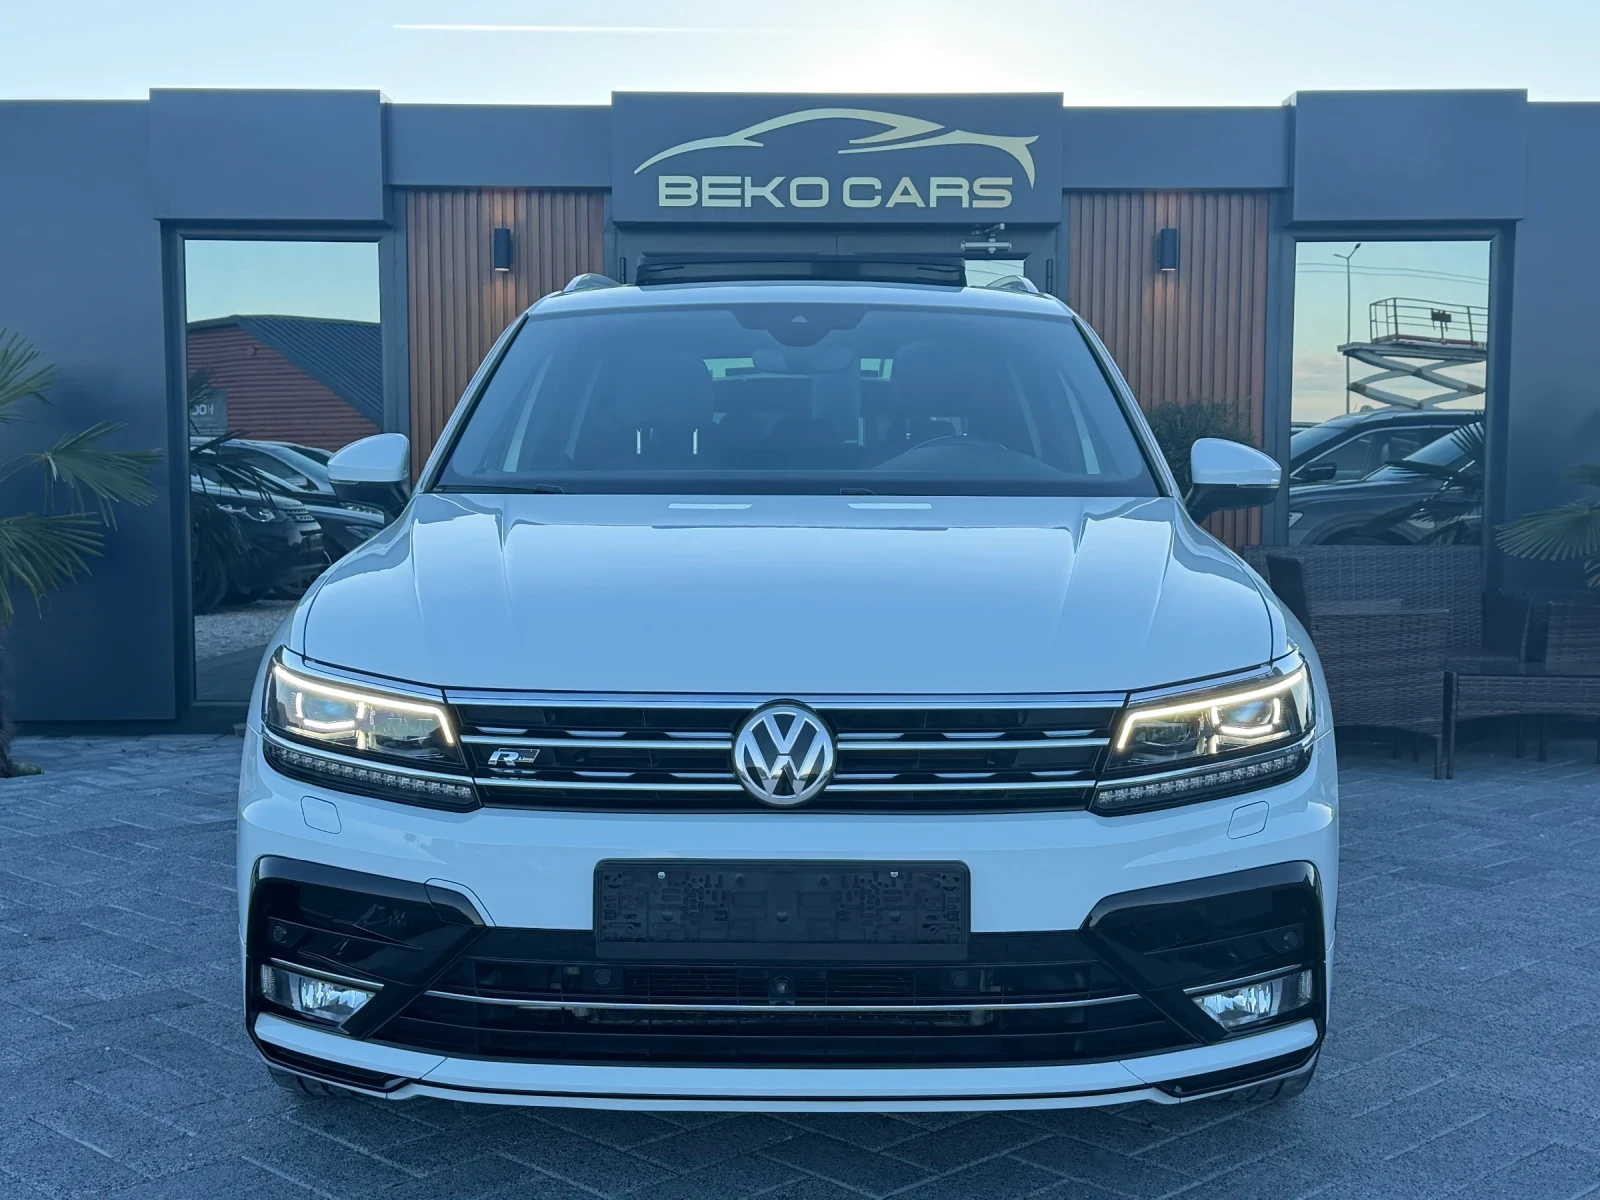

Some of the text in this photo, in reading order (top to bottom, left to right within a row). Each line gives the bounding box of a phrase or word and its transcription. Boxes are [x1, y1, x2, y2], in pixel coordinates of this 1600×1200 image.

[658, 175, 1014, 209] BEKO CARS
[735, 706, 833, 804] VW
